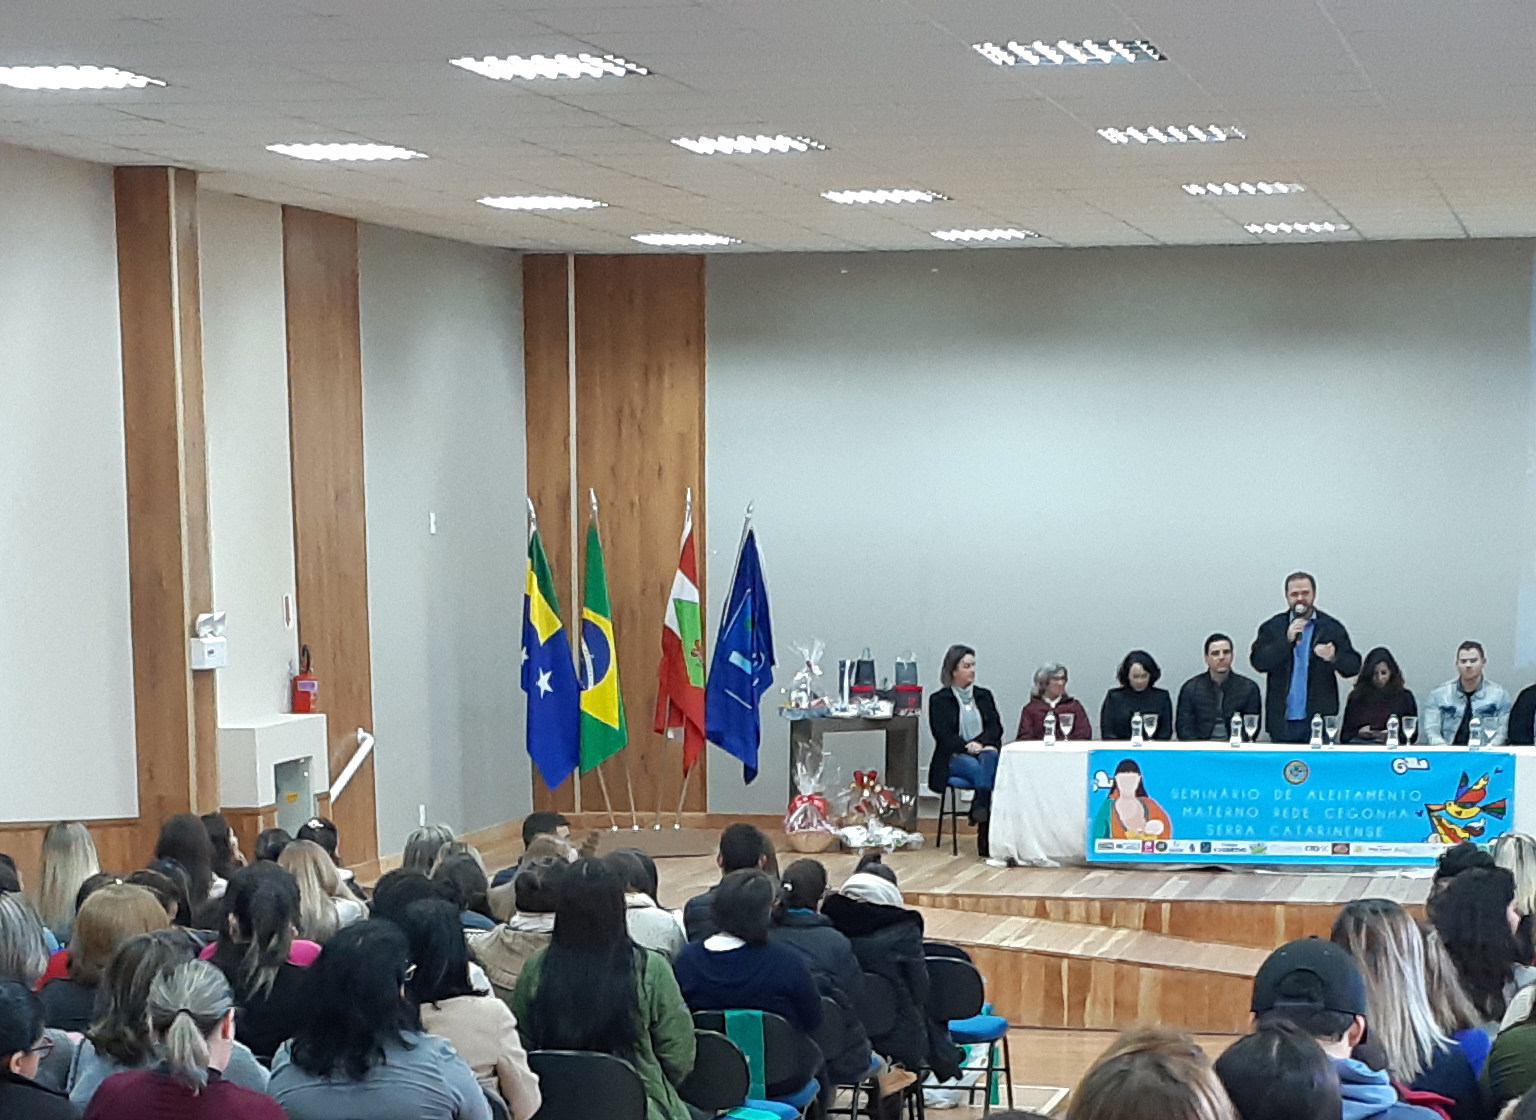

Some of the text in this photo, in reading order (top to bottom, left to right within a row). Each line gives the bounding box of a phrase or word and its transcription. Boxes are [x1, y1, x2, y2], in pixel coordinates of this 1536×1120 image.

[1274, 789, 1292, 800] DE
[1307, 789, 1422, 801] ALEITAMENTO
[1182, 805, 1408, 820] MATERNO REDE CEGONHA
[1206, 824, 1383, 838] SERRA CATARINENSE
